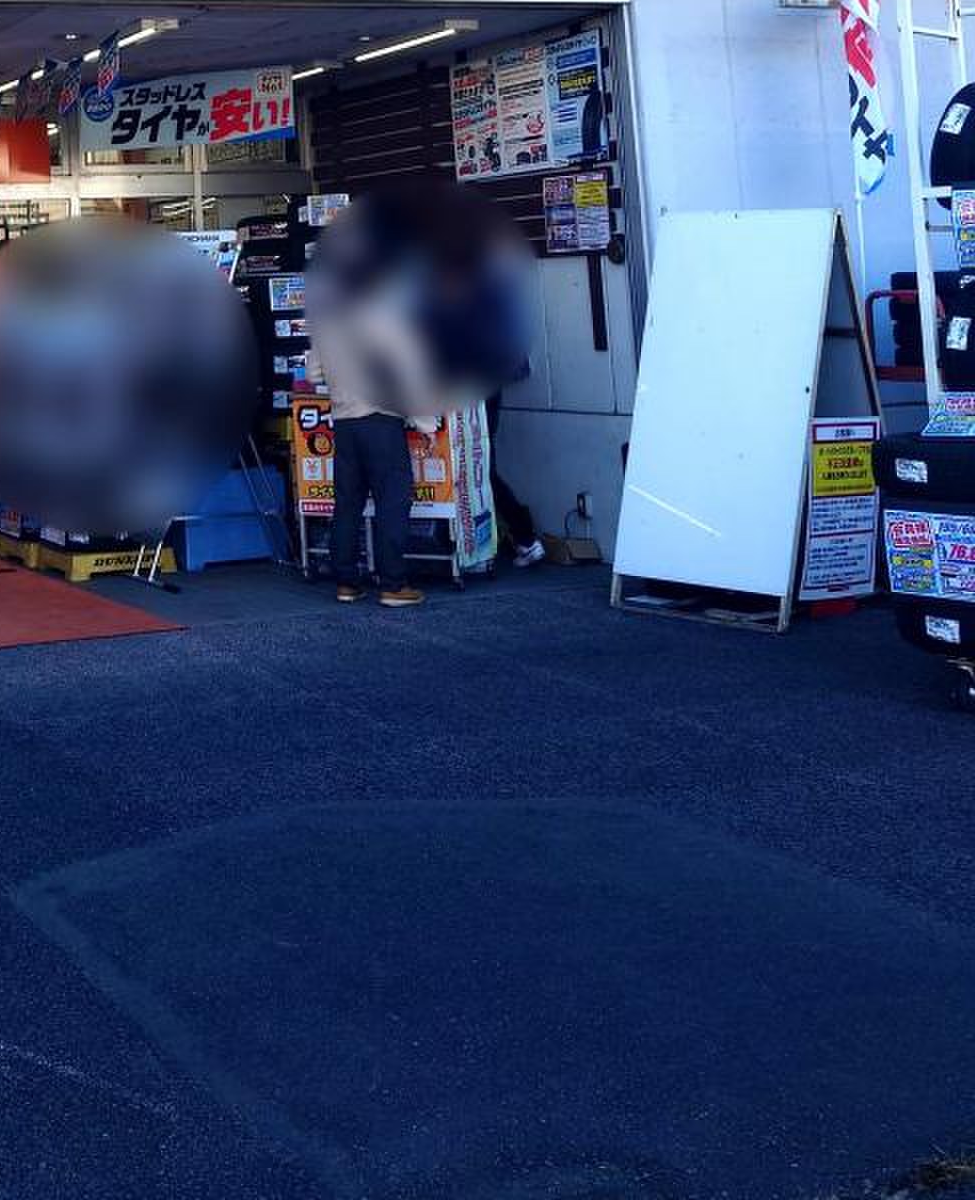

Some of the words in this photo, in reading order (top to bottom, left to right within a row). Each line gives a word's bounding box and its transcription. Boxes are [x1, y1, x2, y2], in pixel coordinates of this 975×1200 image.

[118, 81, 207, 109] スタッドレス
